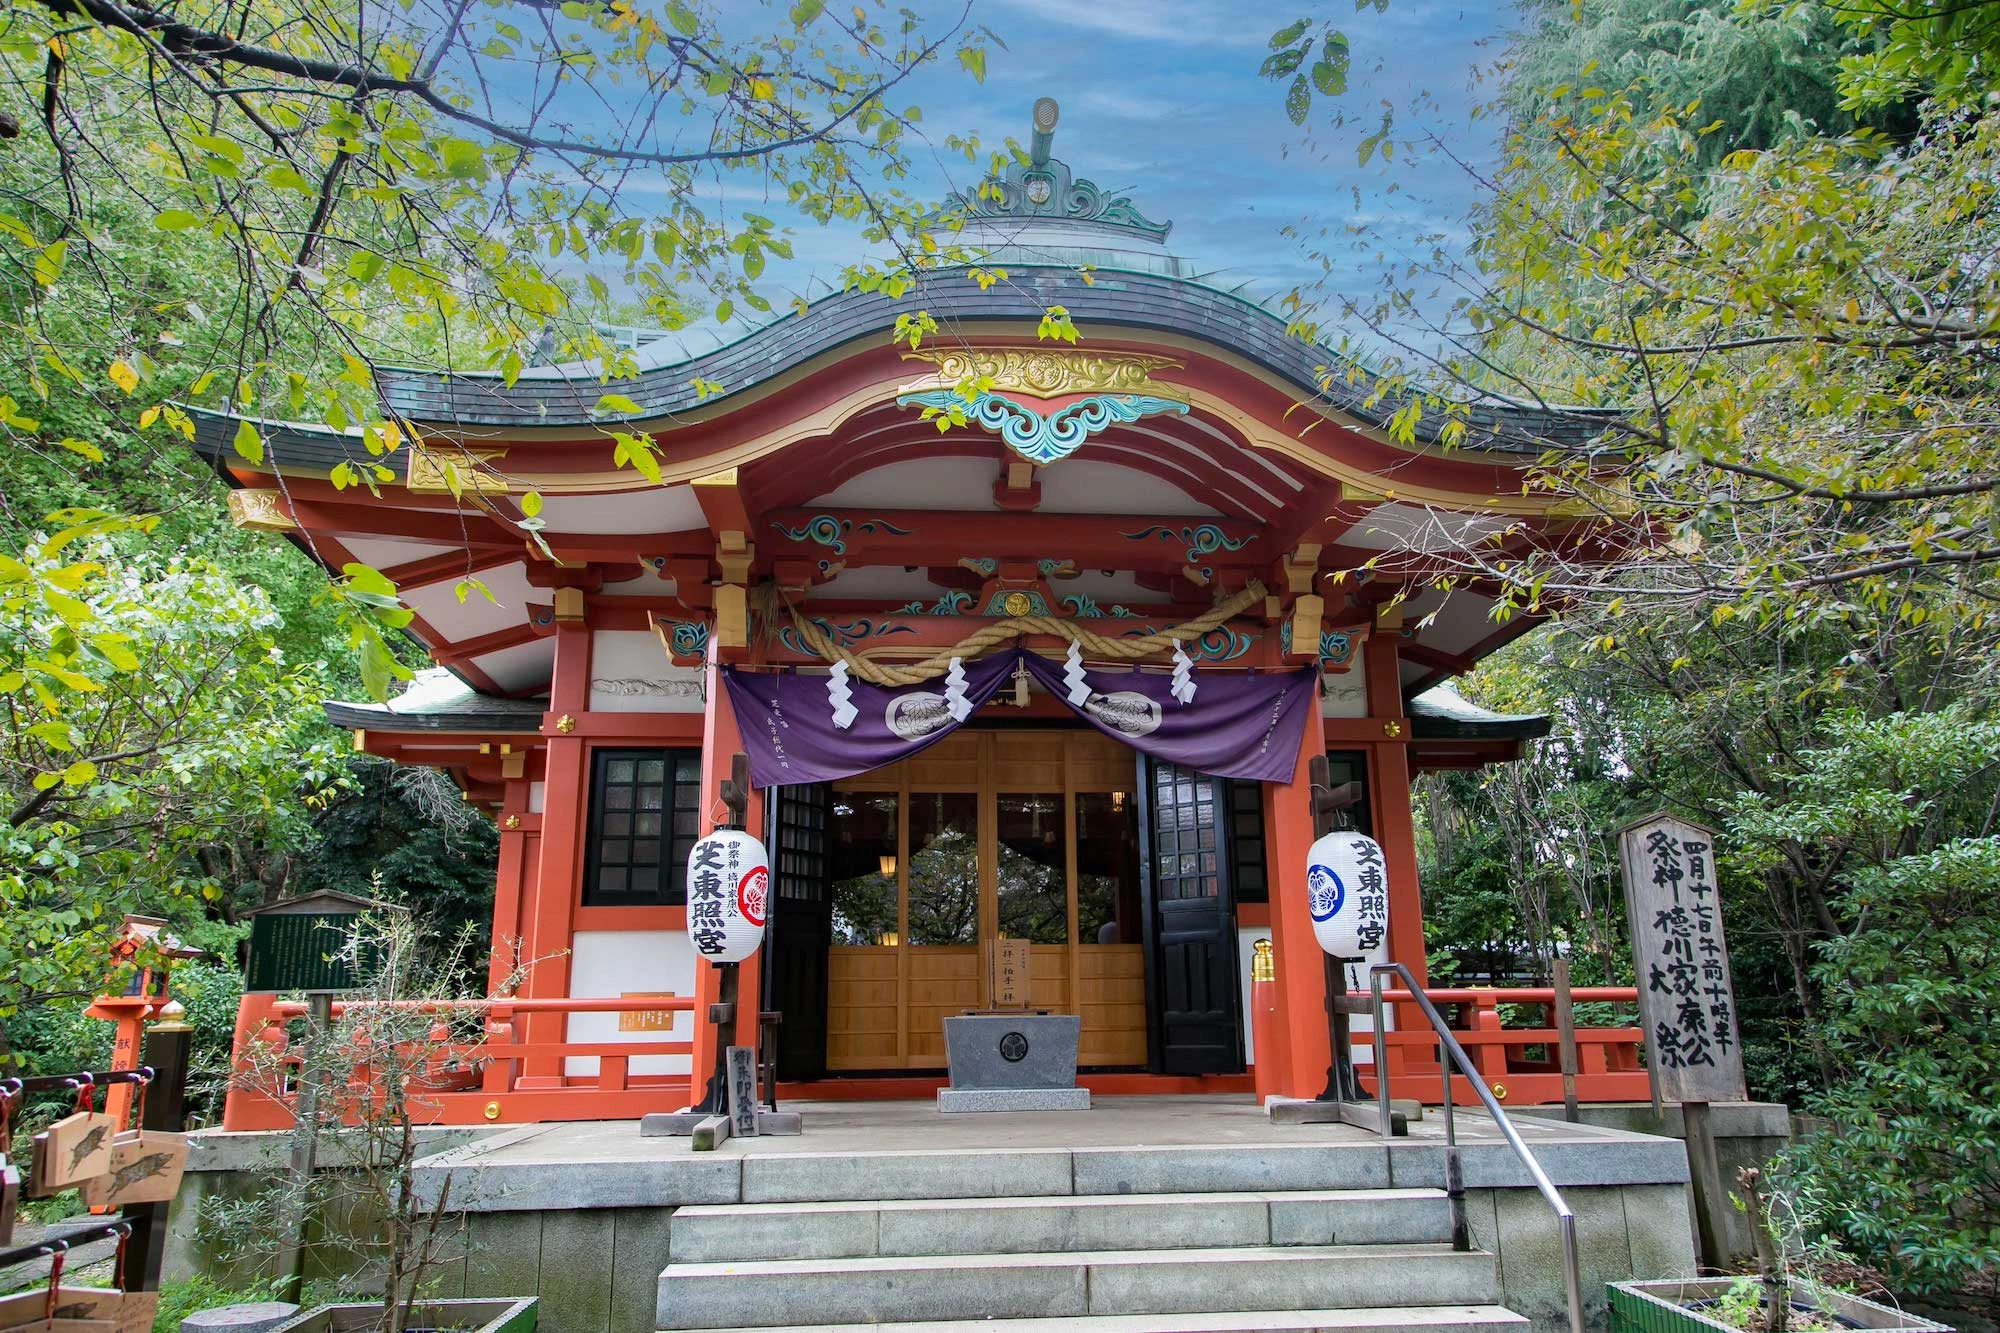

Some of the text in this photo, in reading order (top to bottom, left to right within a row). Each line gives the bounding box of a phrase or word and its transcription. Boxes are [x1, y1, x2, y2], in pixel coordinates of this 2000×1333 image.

[690, 840, 728, 955] 芝東照宮
[1350, 839, 1386, 951] 芝東照宮
[1683, 840, 1734, 1057] 四月十七日午前十時半
[1003, 942, 1015, 1001] 二拝二拍手一拝
